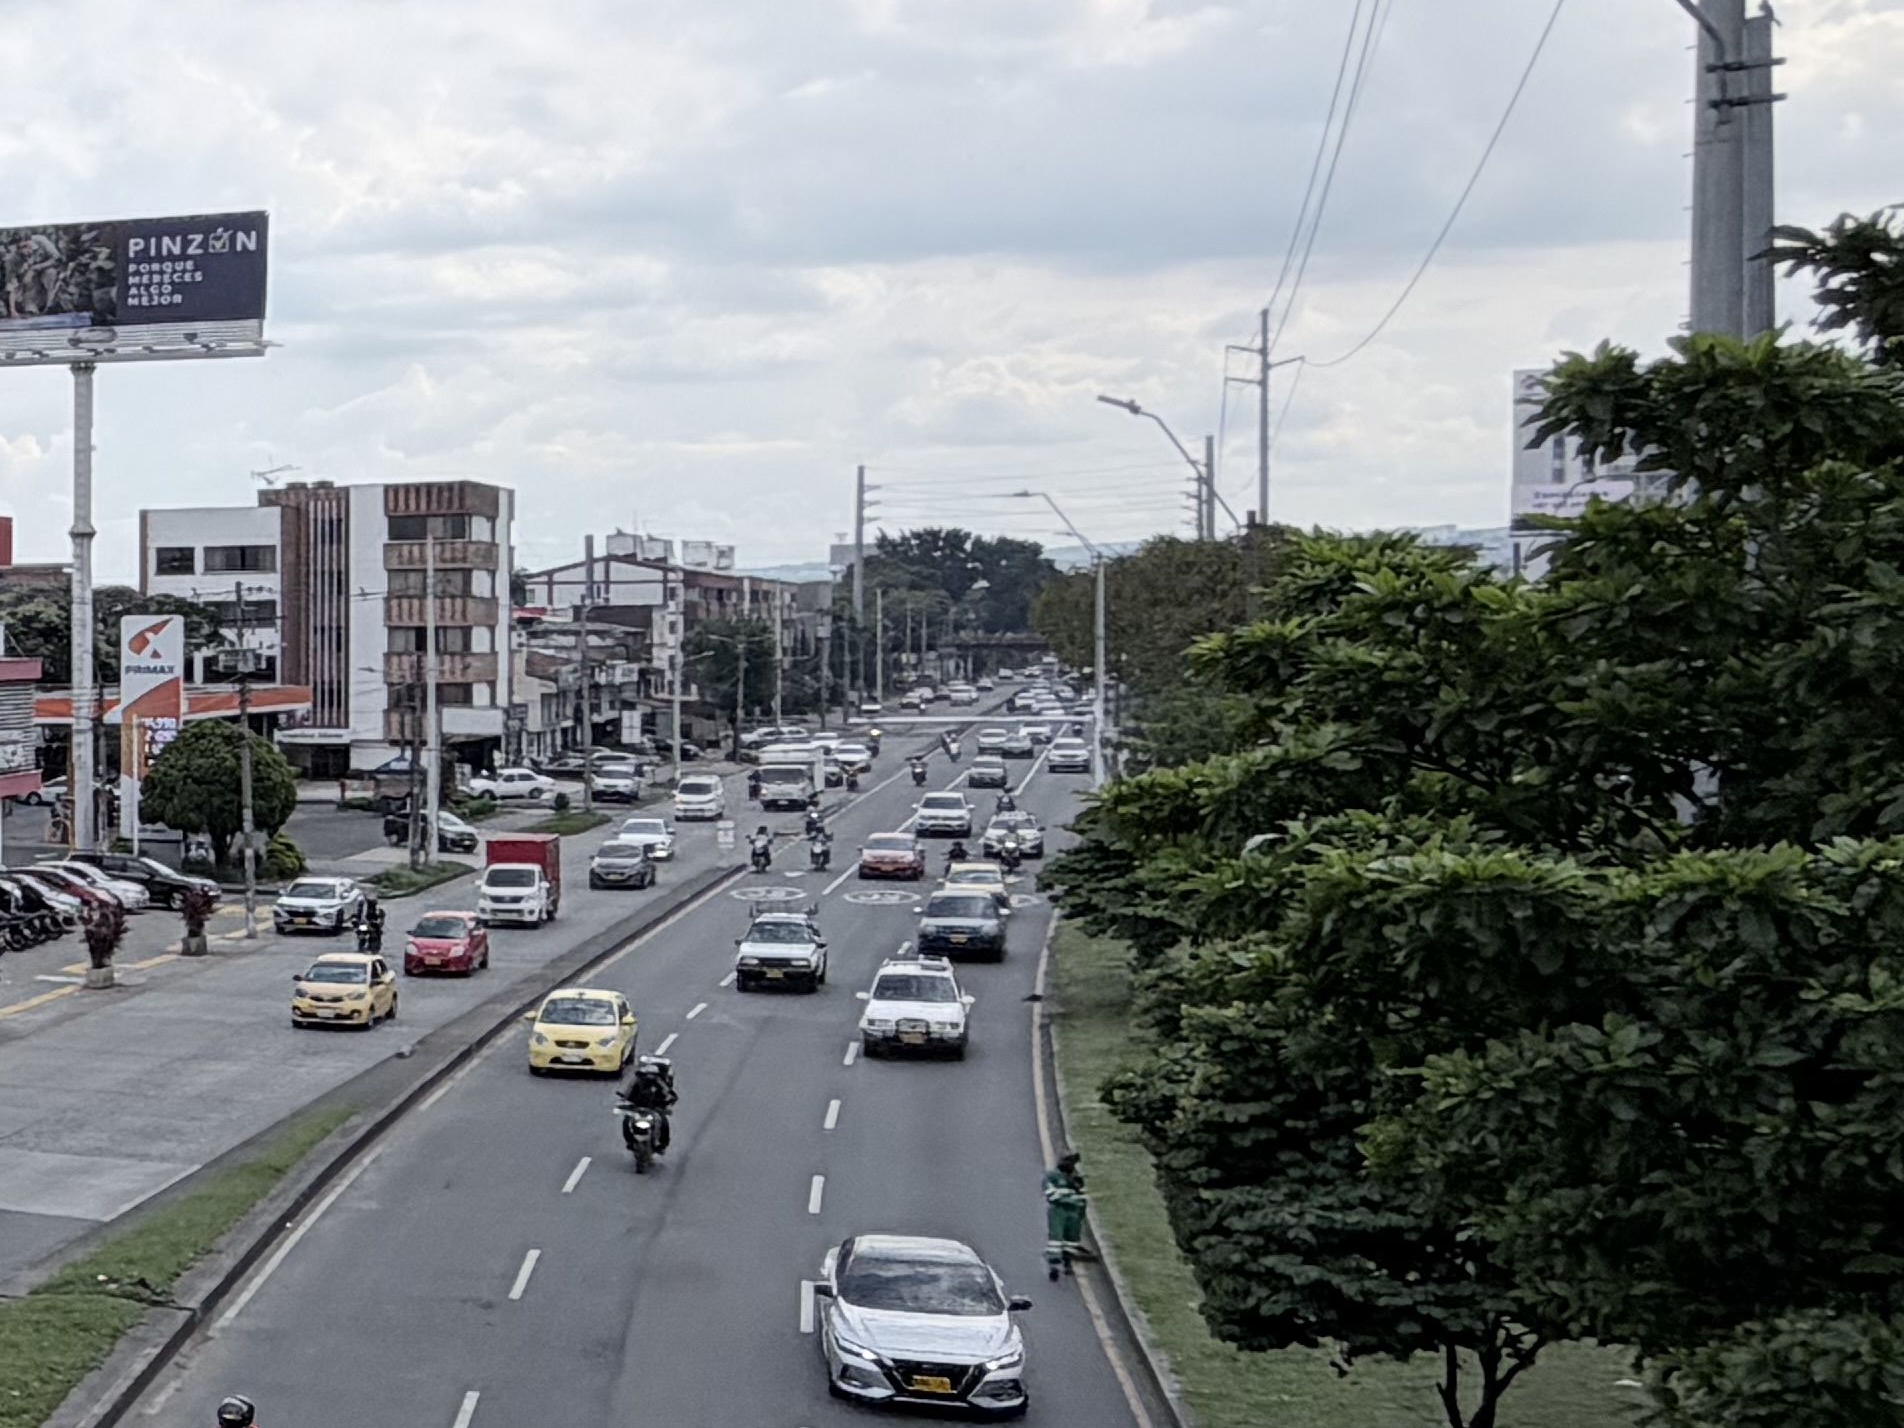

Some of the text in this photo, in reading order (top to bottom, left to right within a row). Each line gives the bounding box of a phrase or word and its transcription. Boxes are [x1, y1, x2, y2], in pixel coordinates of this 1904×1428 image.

[128, 260, 195, 273] PORQUE
[128, 271, 203, 285] MERECES
[128, 284, 172, 296] ALGO
[127, 293, 182, 306] MEJOR
